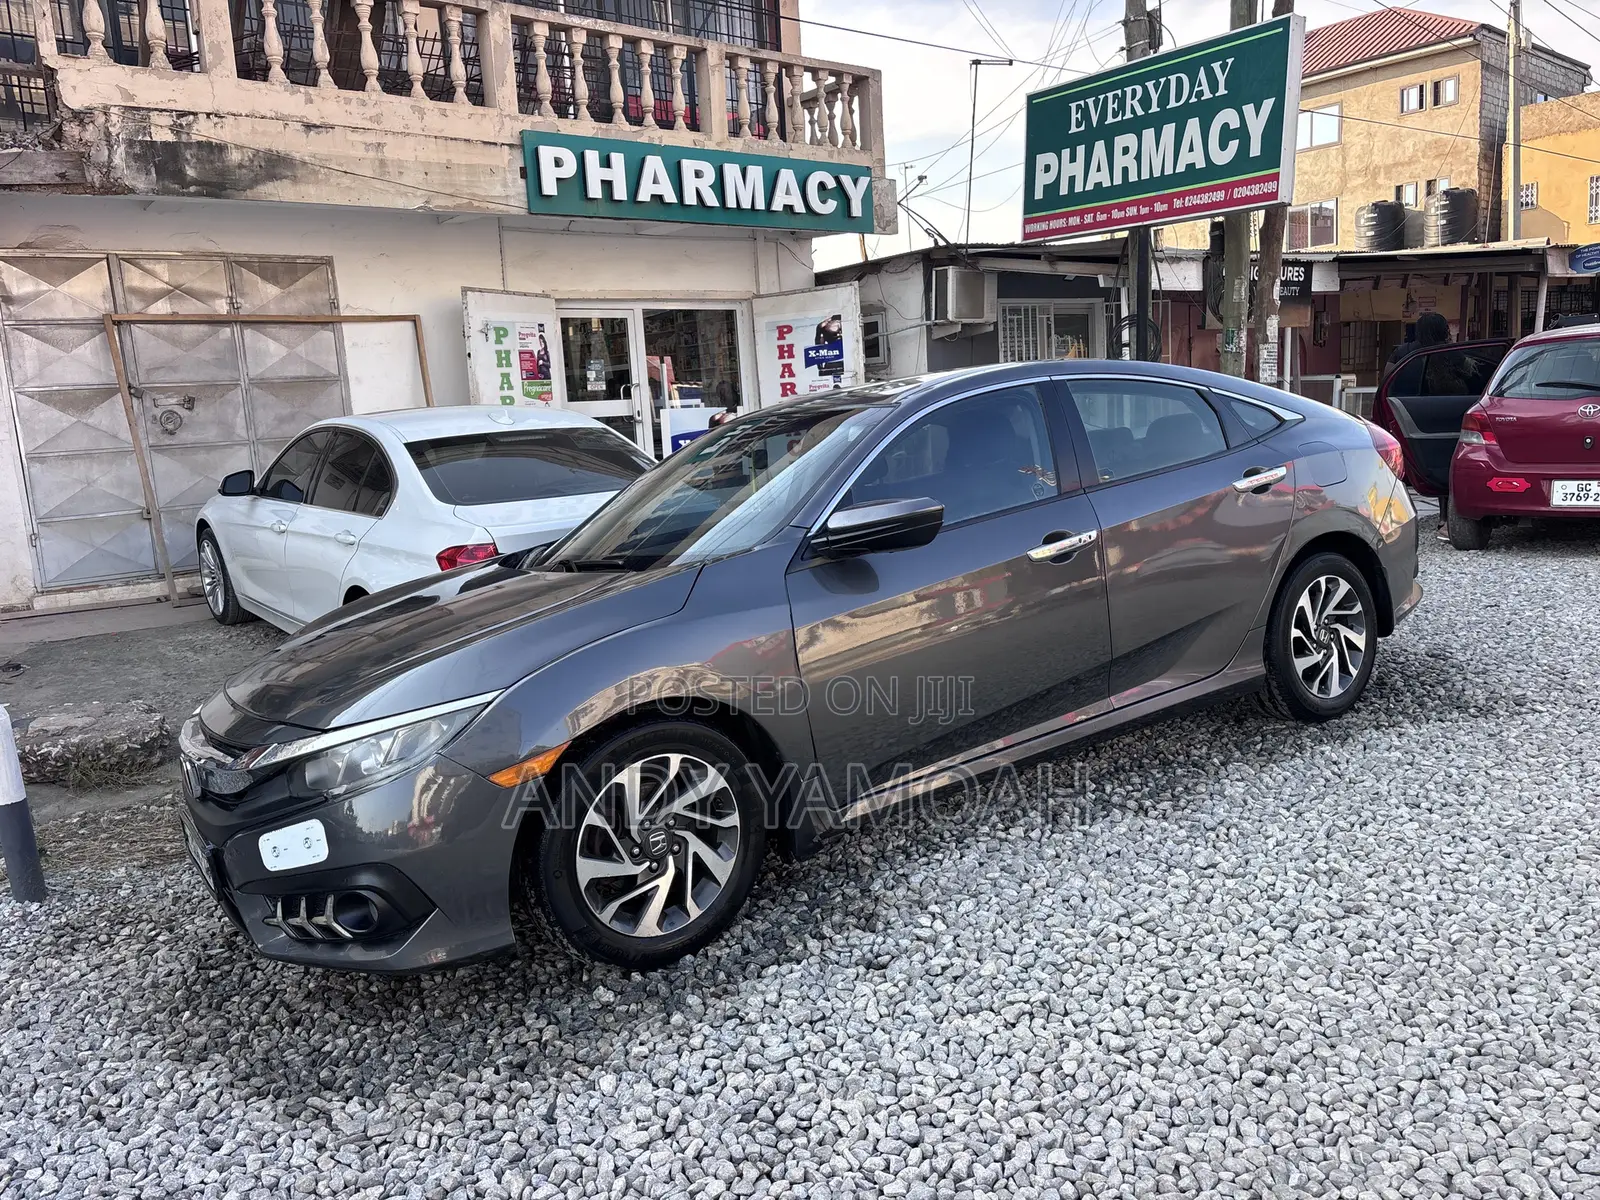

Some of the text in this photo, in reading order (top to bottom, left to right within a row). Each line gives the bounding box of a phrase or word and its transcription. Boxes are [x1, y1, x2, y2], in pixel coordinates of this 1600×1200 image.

[1068, 57, 1235, 134] EVERYDAY
[1034, 97, 1276, 200] PHARMACY
[537, 145, 872, 218] PHARMACY
[1025, 221, 1049, 234] WORKING
[1049, 218, 1067, 229] HOURS:
[1096, 211, 1107, 222] 6am
[1111, 209, 1125, 219] 10pm
[1139, 205, 1149, 216] 1pm
[1153, 201, 1168, 213] 10pm
[1233, 180, 1278, 199] 0204382499
[1280, 286, 1301, 296] EAUTY
[808, 349, 840, 358] X-Man
[1576, 483, 1592, 492] GC
